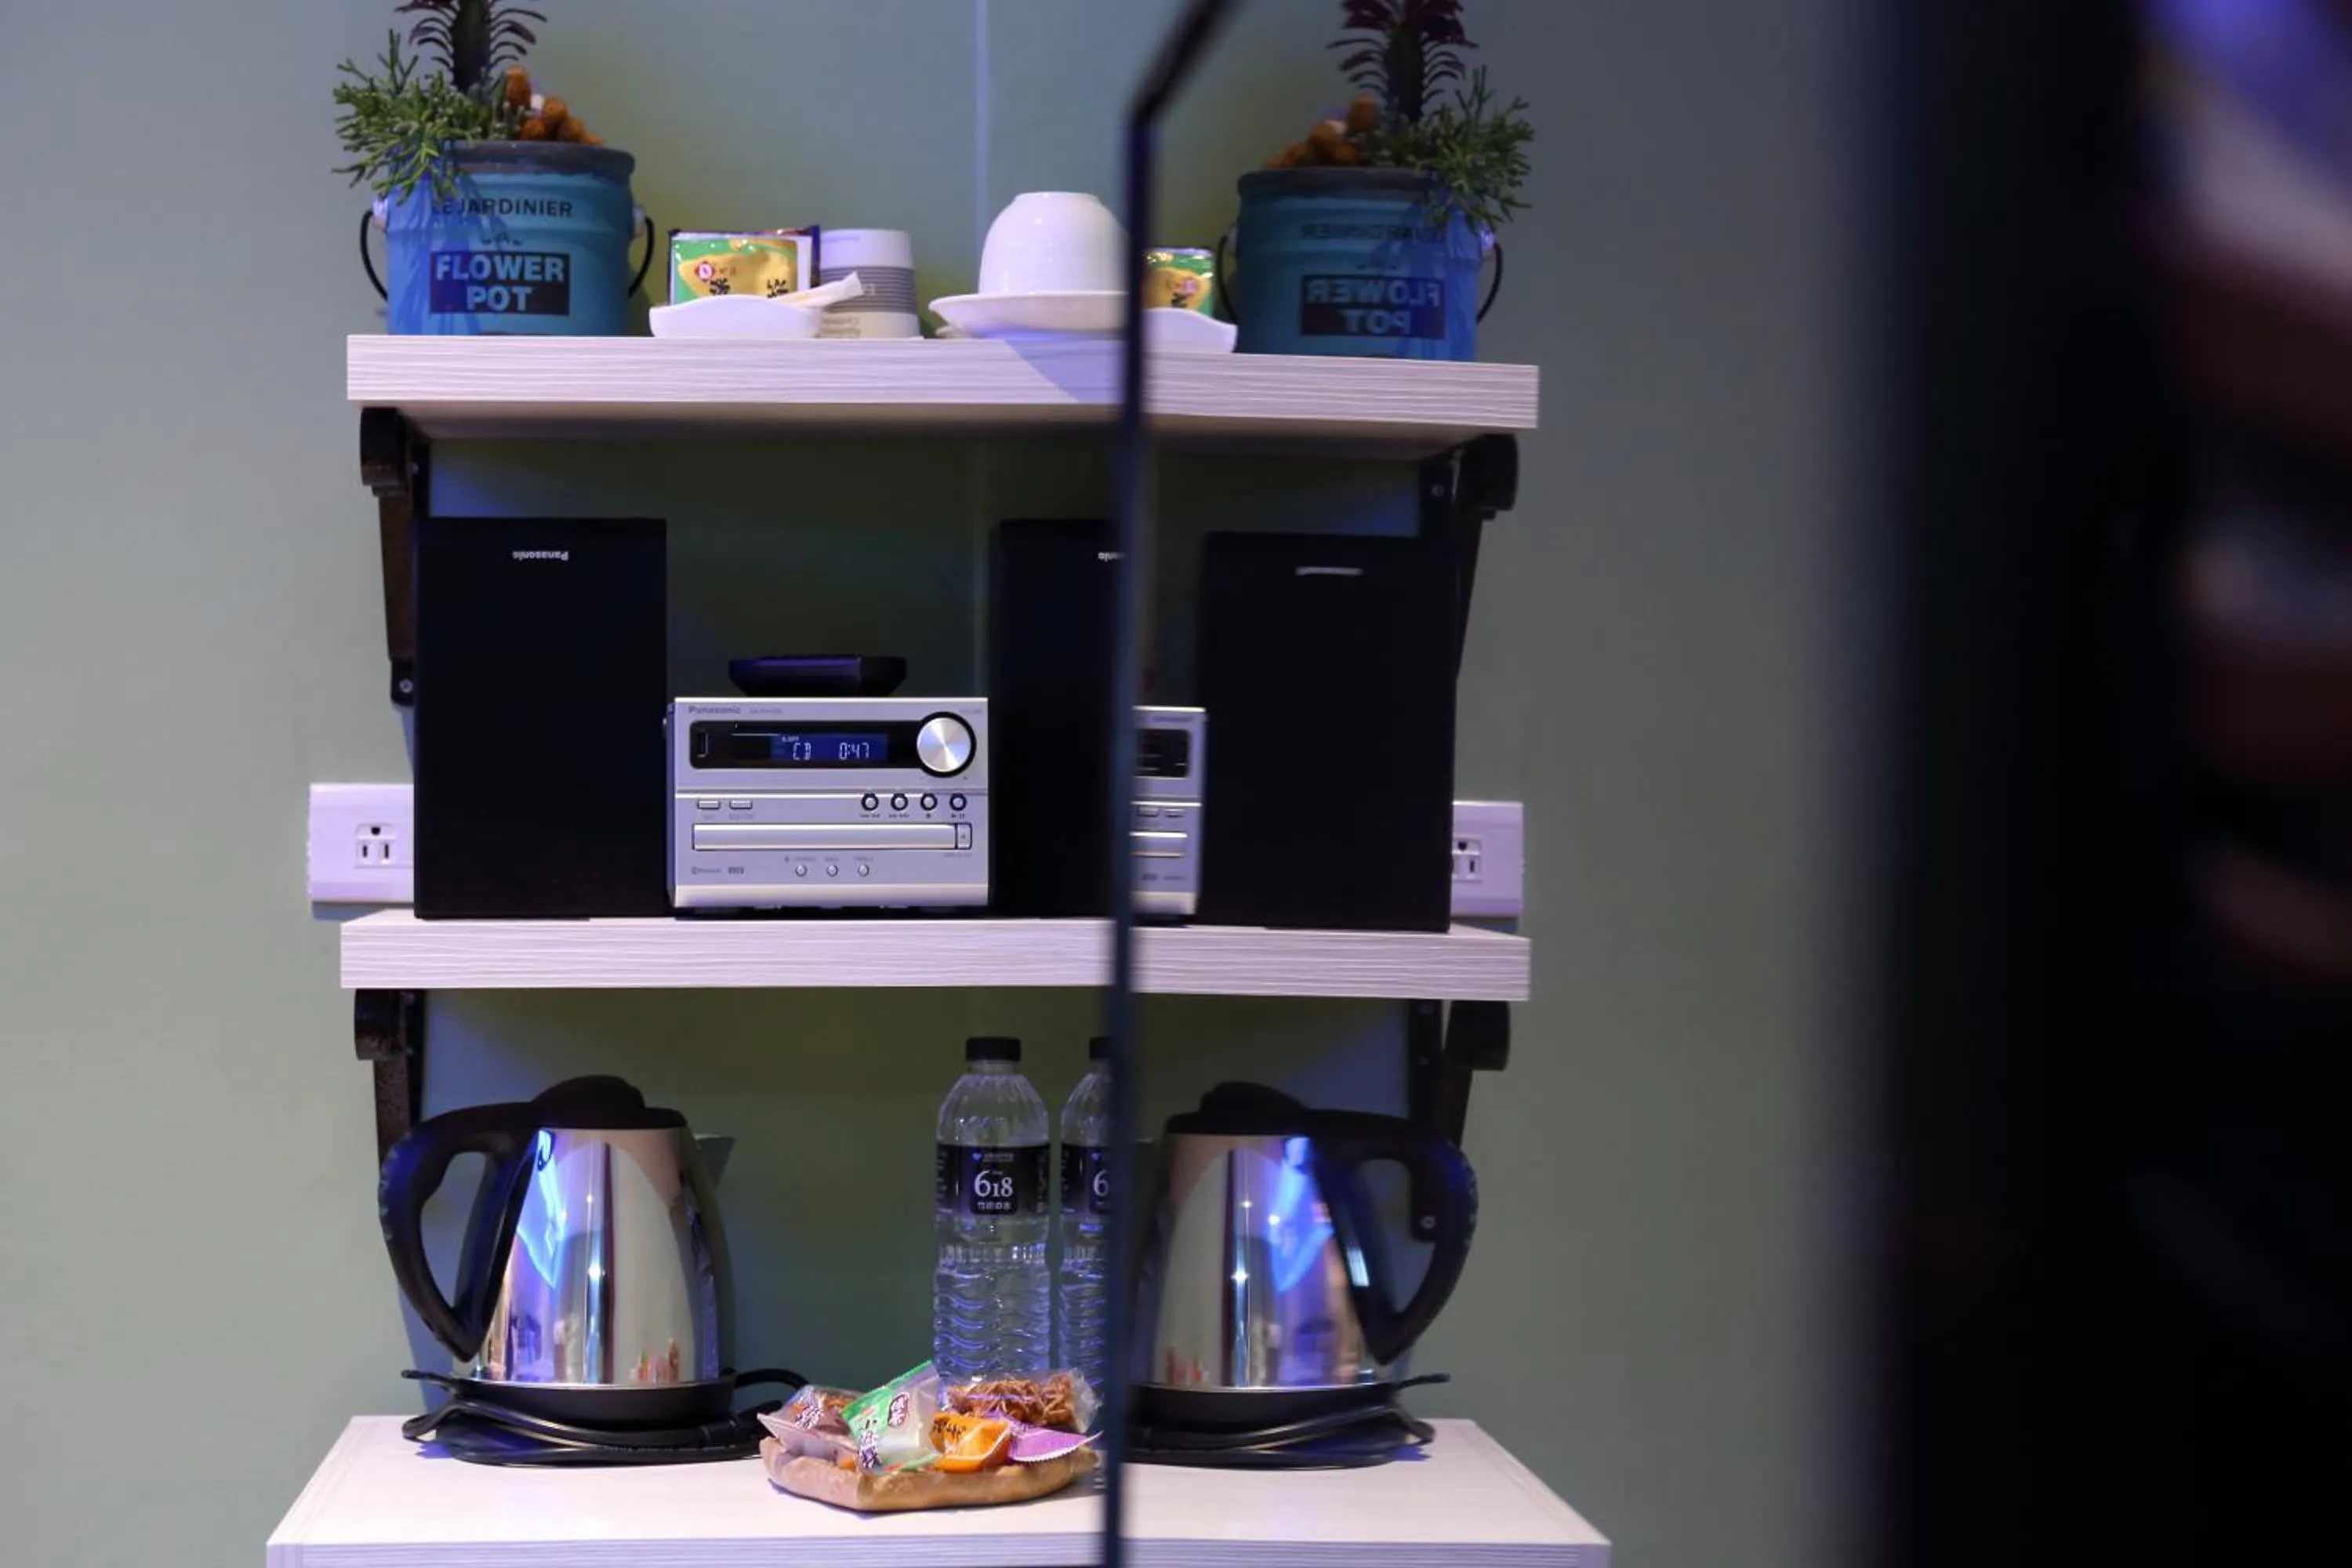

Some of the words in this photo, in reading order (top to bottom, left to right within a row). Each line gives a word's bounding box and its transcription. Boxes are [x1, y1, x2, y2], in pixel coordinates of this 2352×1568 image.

[459, 198, 573, 218] JARDINIER
[436, 254, 564, 282] FLOWER
[466, 285, 533, 312] POT
[839, 742, 869, 760] 0:47
[975, 1169, 1014, 1198] 618
